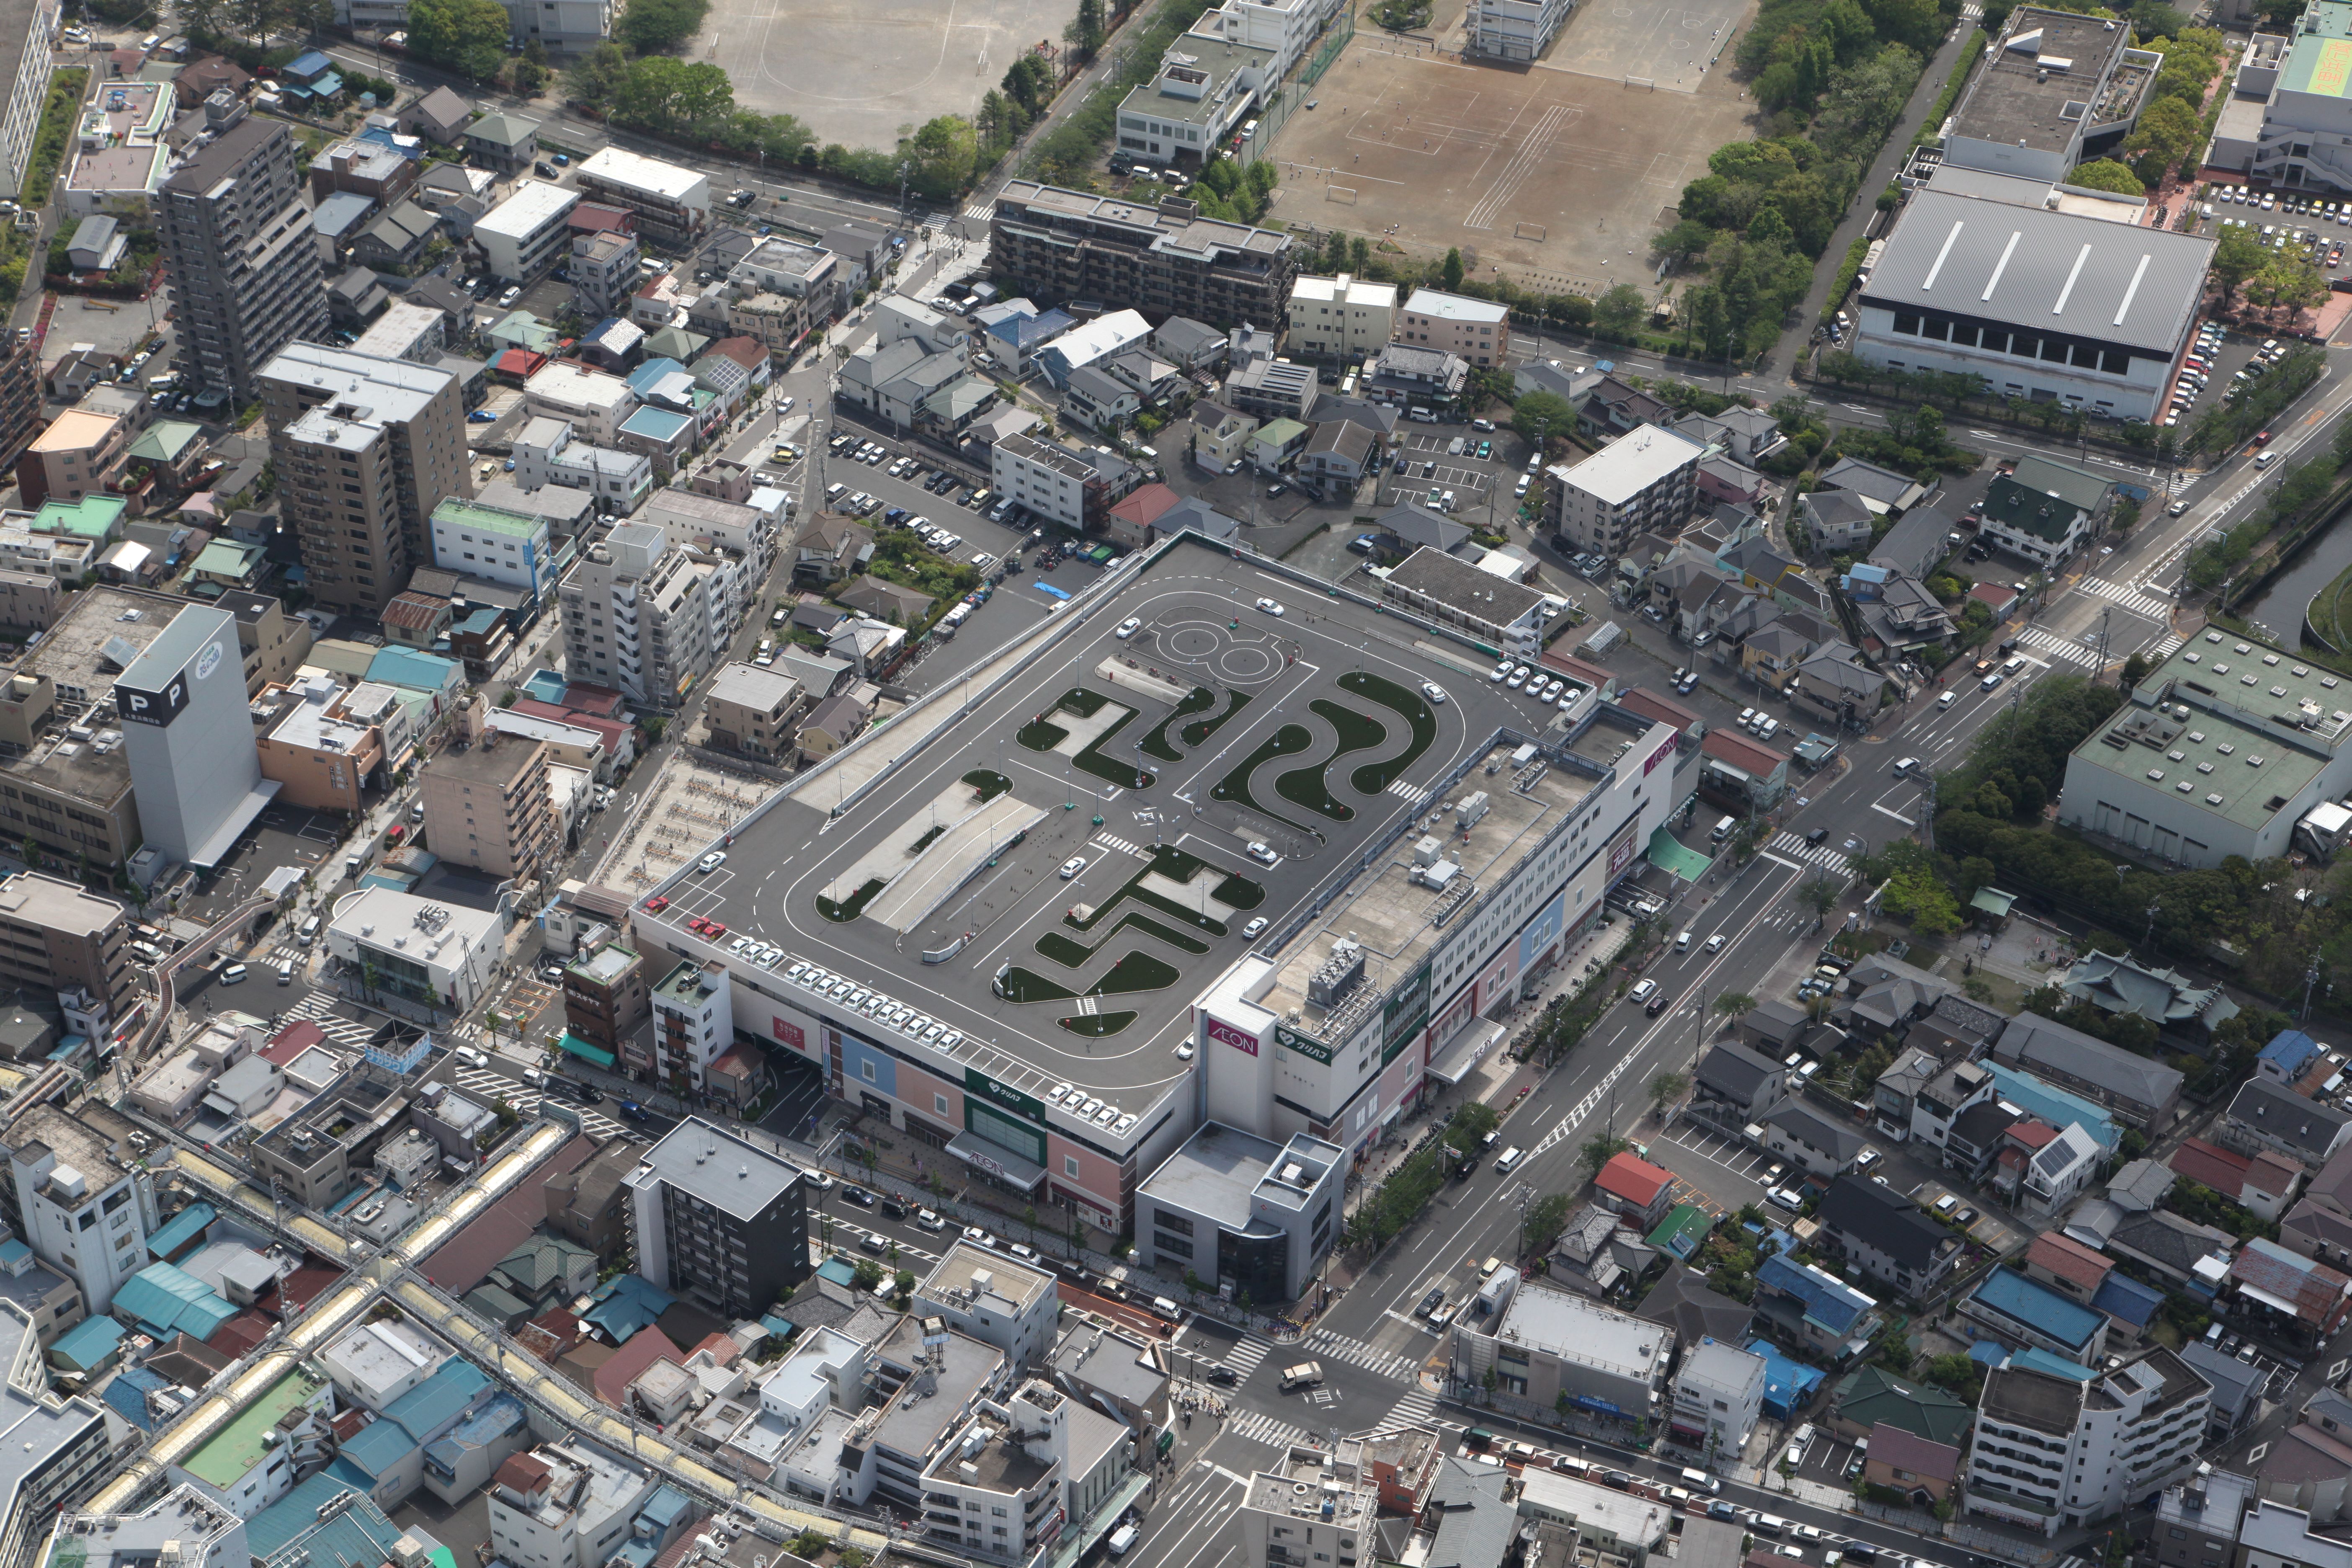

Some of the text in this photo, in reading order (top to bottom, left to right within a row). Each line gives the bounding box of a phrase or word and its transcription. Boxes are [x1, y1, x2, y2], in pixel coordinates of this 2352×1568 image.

[130, 694, 148, 712] P
[170, 684, 181, 707] P
[368, 1052, 401, 1071] ナガサワ
